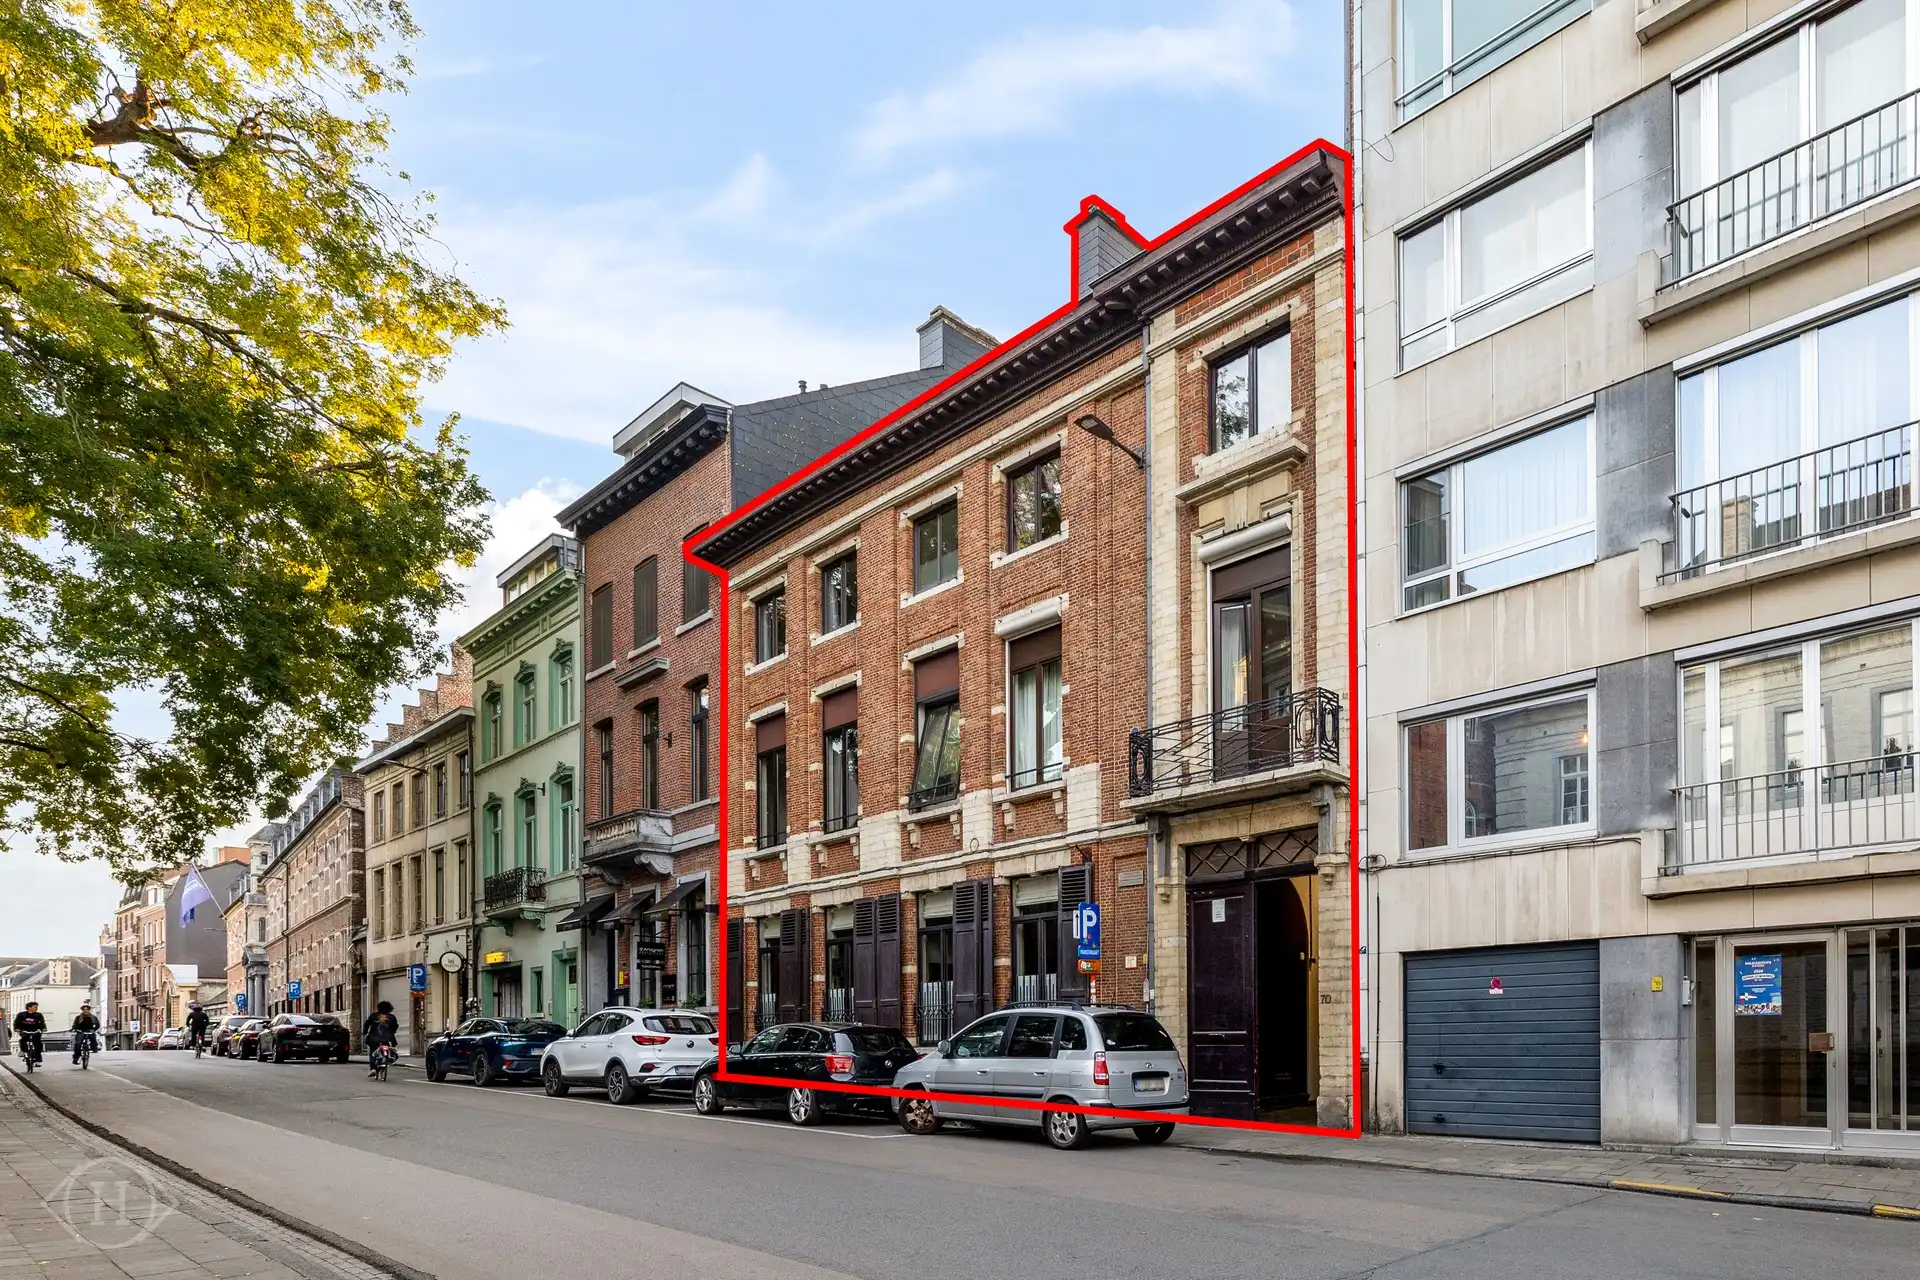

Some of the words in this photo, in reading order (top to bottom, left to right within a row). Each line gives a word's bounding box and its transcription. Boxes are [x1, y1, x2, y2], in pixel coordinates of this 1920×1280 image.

[1083, 910, 1097, 938] P
[413, 968, 424, 983] P
[1320, 994, 1331, 1004] 70
